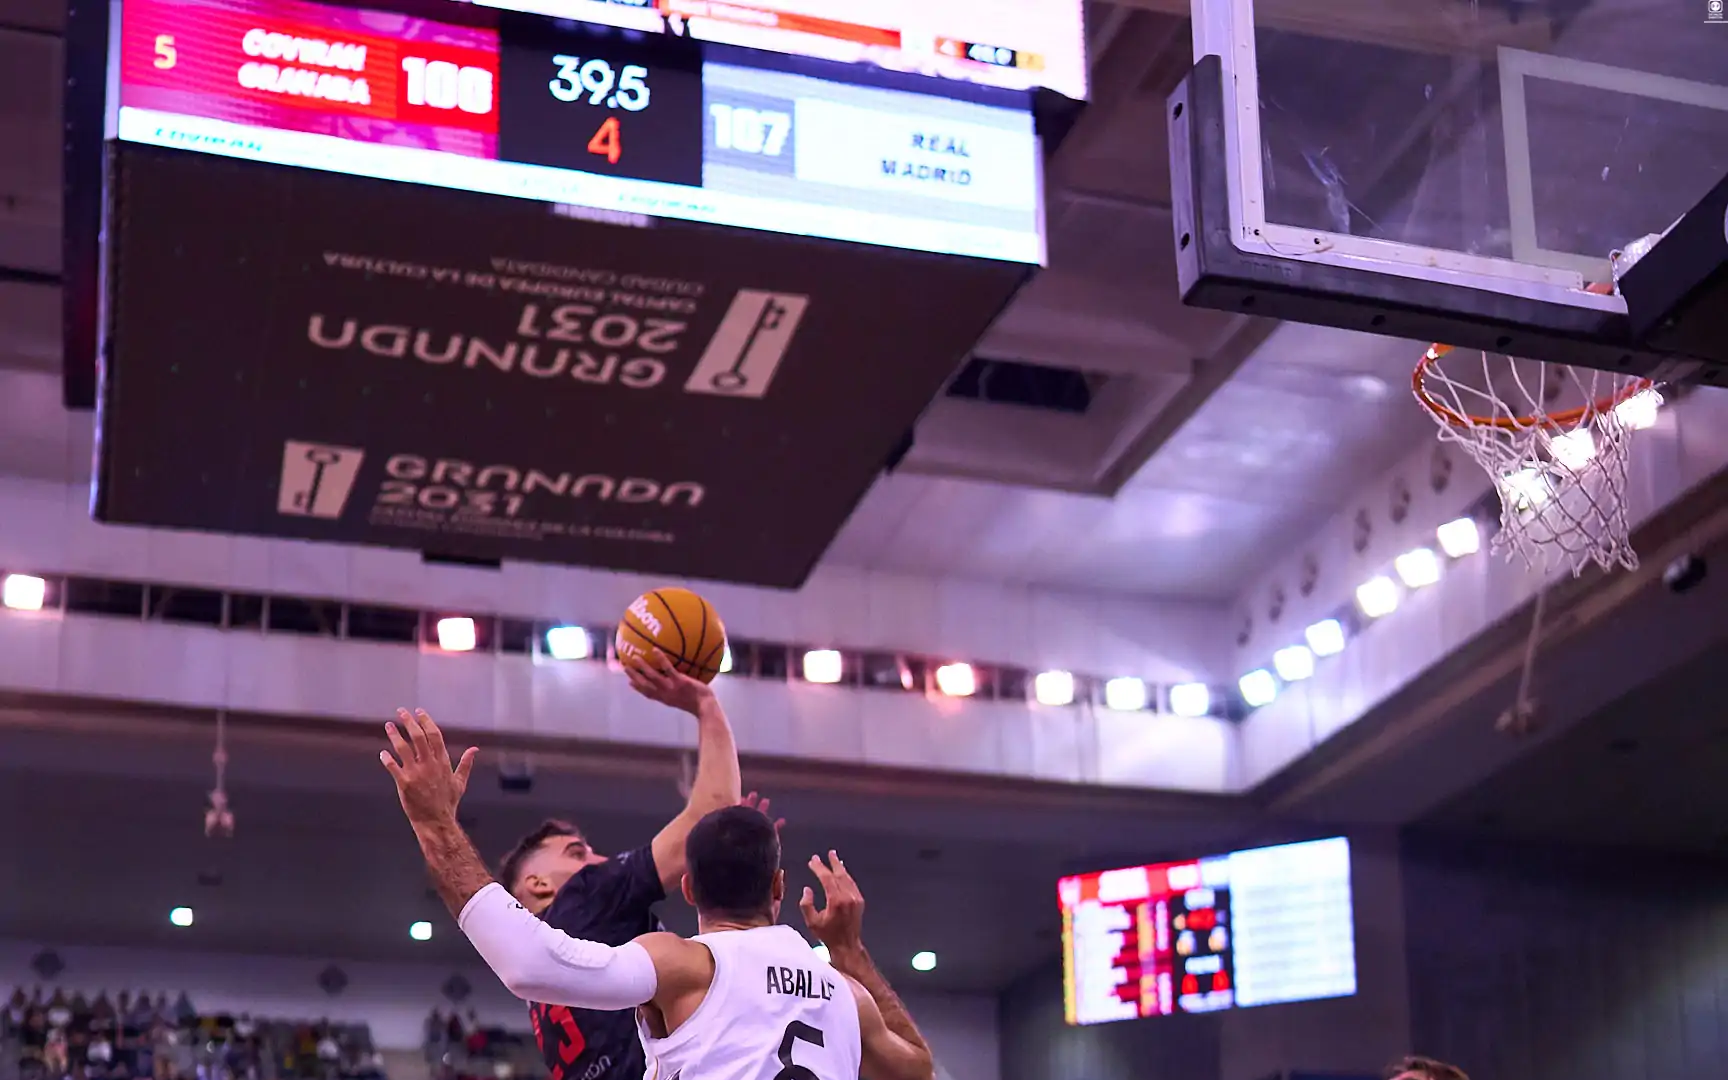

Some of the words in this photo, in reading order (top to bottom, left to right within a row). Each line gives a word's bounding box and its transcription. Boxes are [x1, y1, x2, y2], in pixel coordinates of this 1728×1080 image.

[154, 34, 177, 70] 5
[549, 54, 651, 112] 39.5
[587, 116, 622, 164] 4
[709, 103, 791, 157] 107
[912, 132, 971, 158] REAL
[881, 159, 973, 186] MADRID
[518, 302, 687, 353] 2031
